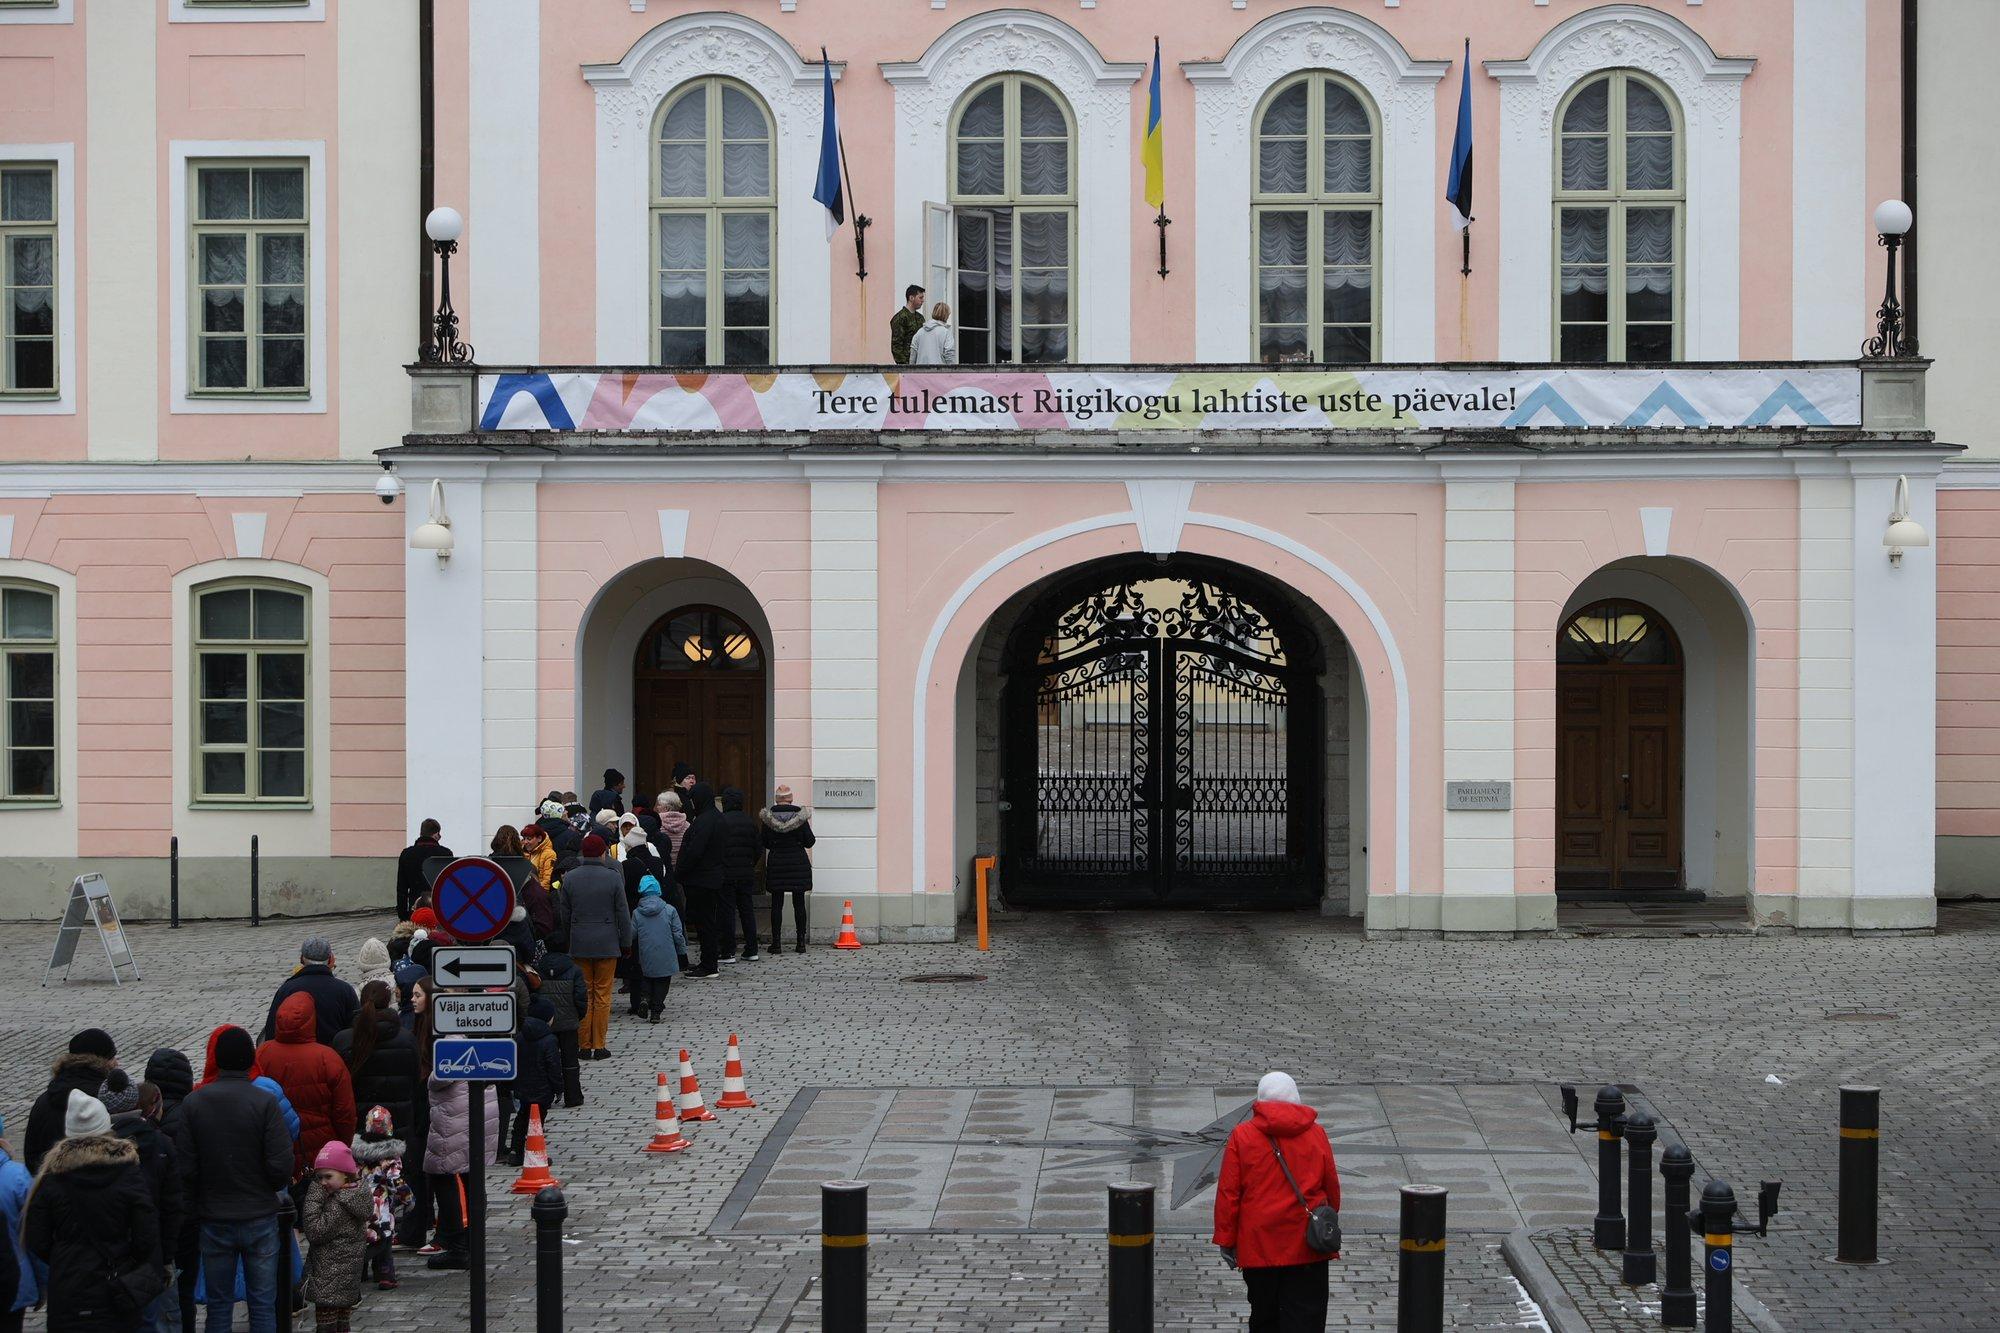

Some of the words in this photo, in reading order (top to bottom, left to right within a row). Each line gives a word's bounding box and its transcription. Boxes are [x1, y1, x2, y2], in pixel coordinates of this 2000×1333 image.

[812, 390, 878, 414] Tere
[887, 389, 1024, 414] tulemast
[1033, 388, 1182, 420] Riigikogu
[1192, 388, 1308, 413] lahtiste
[1318, 391, 1382, 413] uste
[1392, 387, 1517, 419] päevale!
[439, 1001, 466, 1015] Välja
[468, 1001, 509, 1012] arvatud
[456, 1016, 492, 1028] taksod
